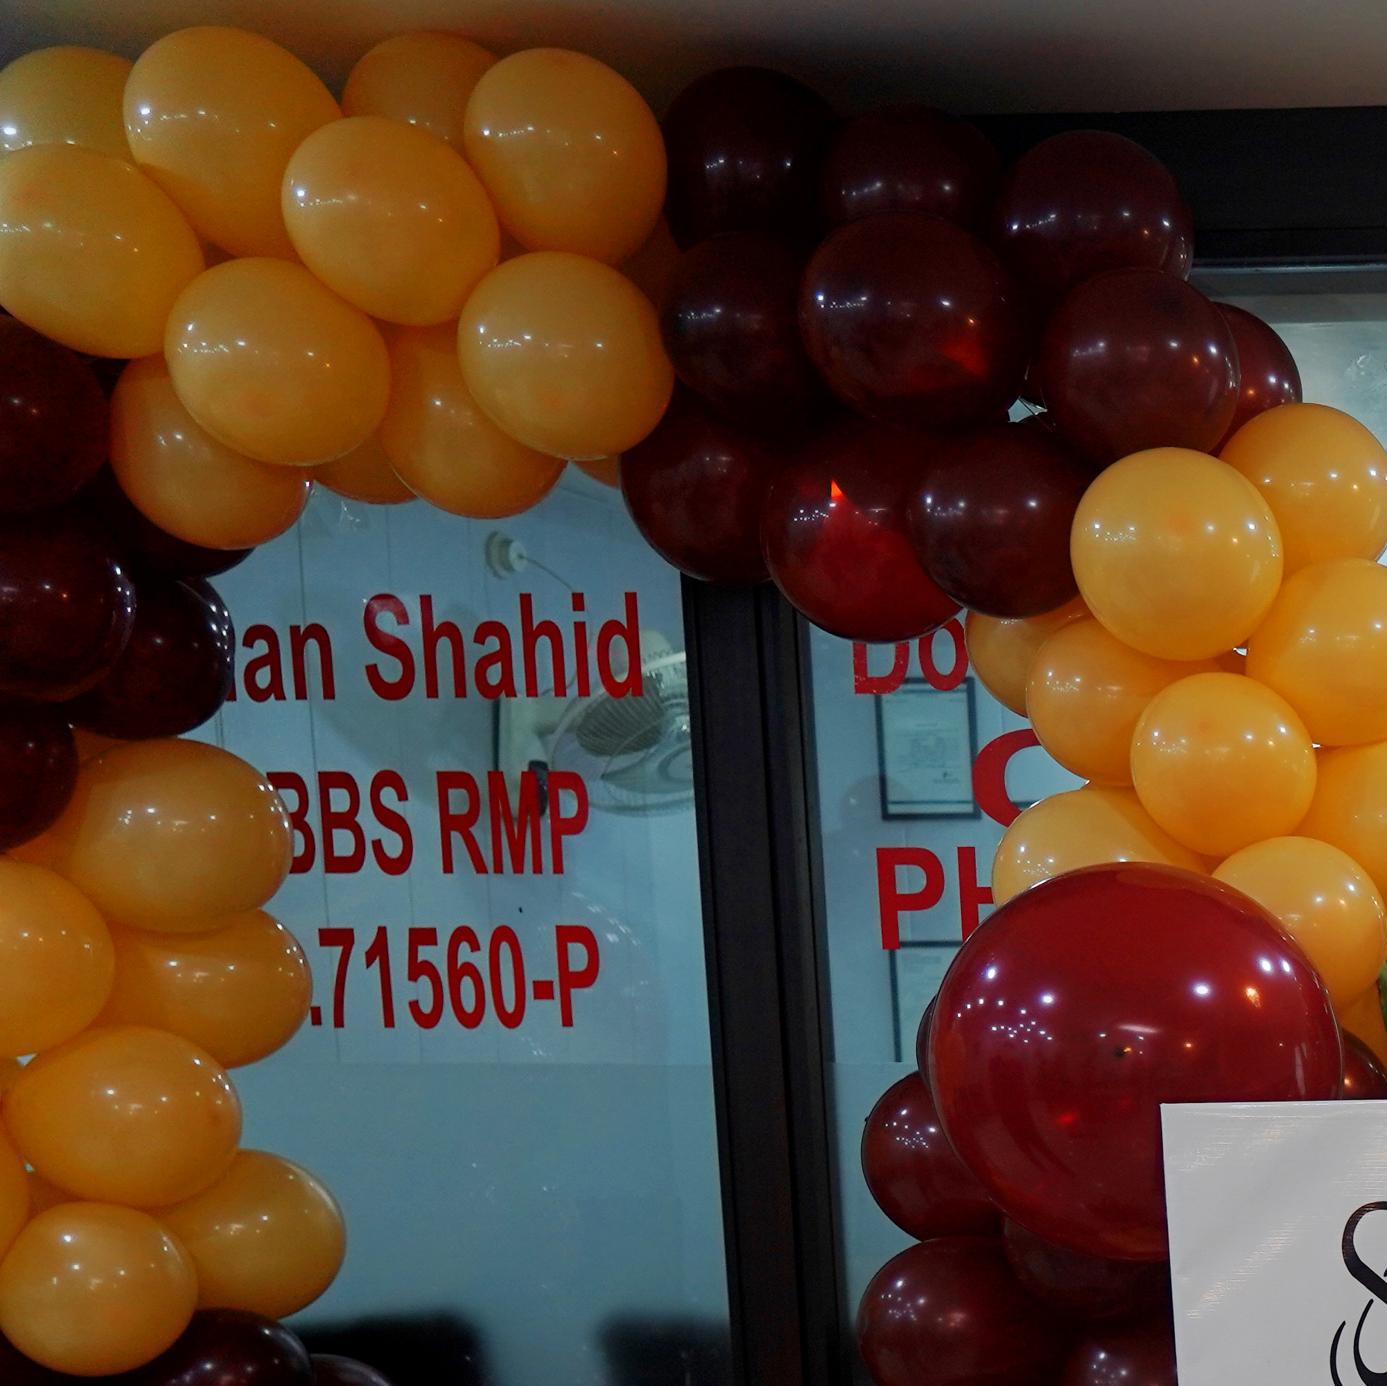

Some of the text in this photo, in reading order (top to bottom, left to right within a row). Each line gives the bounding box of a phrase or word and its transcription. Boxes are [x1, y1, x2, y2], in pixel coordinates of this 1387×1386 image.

[225, 591, 644, 702] an Shahid
[436, 771, 590, 875] RMP
